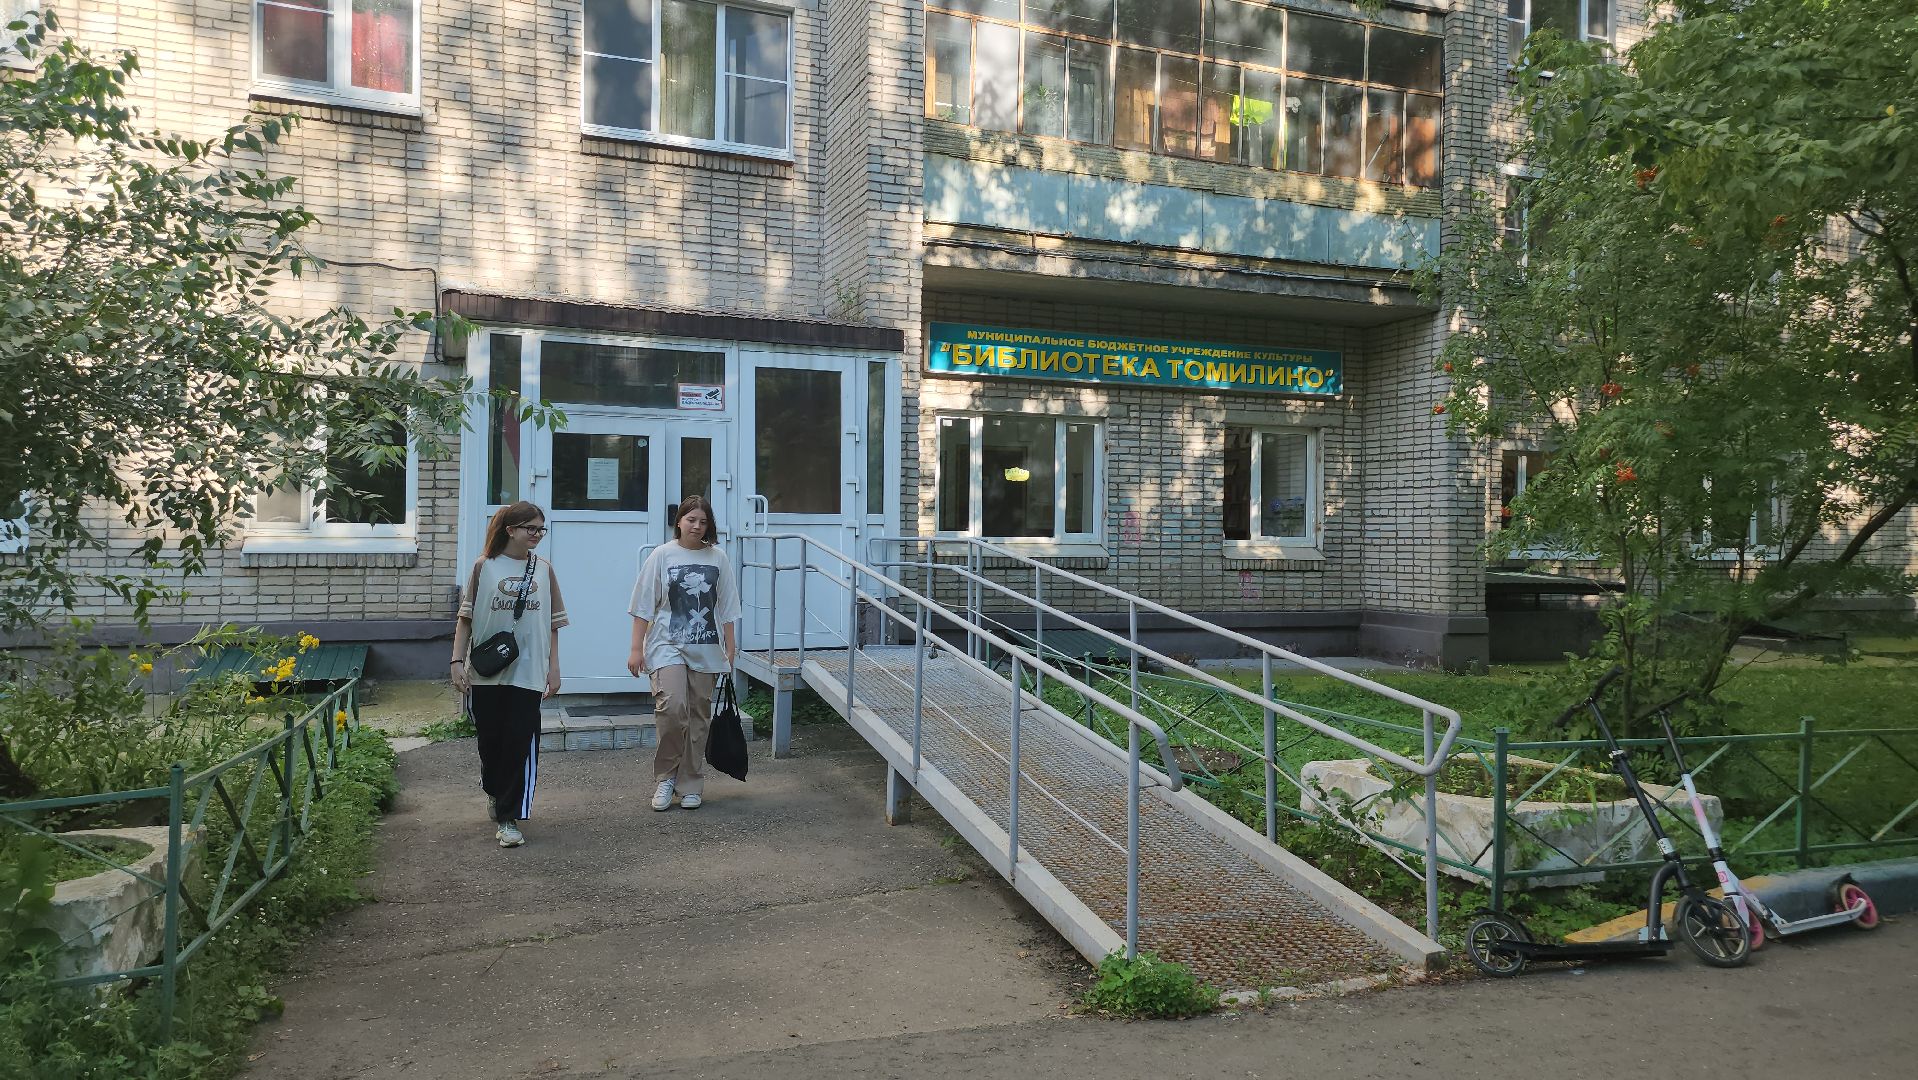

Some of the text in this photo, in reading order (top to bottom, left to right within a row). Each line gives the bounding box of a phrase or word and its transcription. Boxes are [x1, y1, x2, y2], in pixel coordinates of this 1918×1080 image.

[967, 330, 1313, 363] МУНИЦИПАЛЬНОЕ БЮДЖЕТНОЕ УЧРЕЖДЕНИЕ КУЛЬТУРЫ
